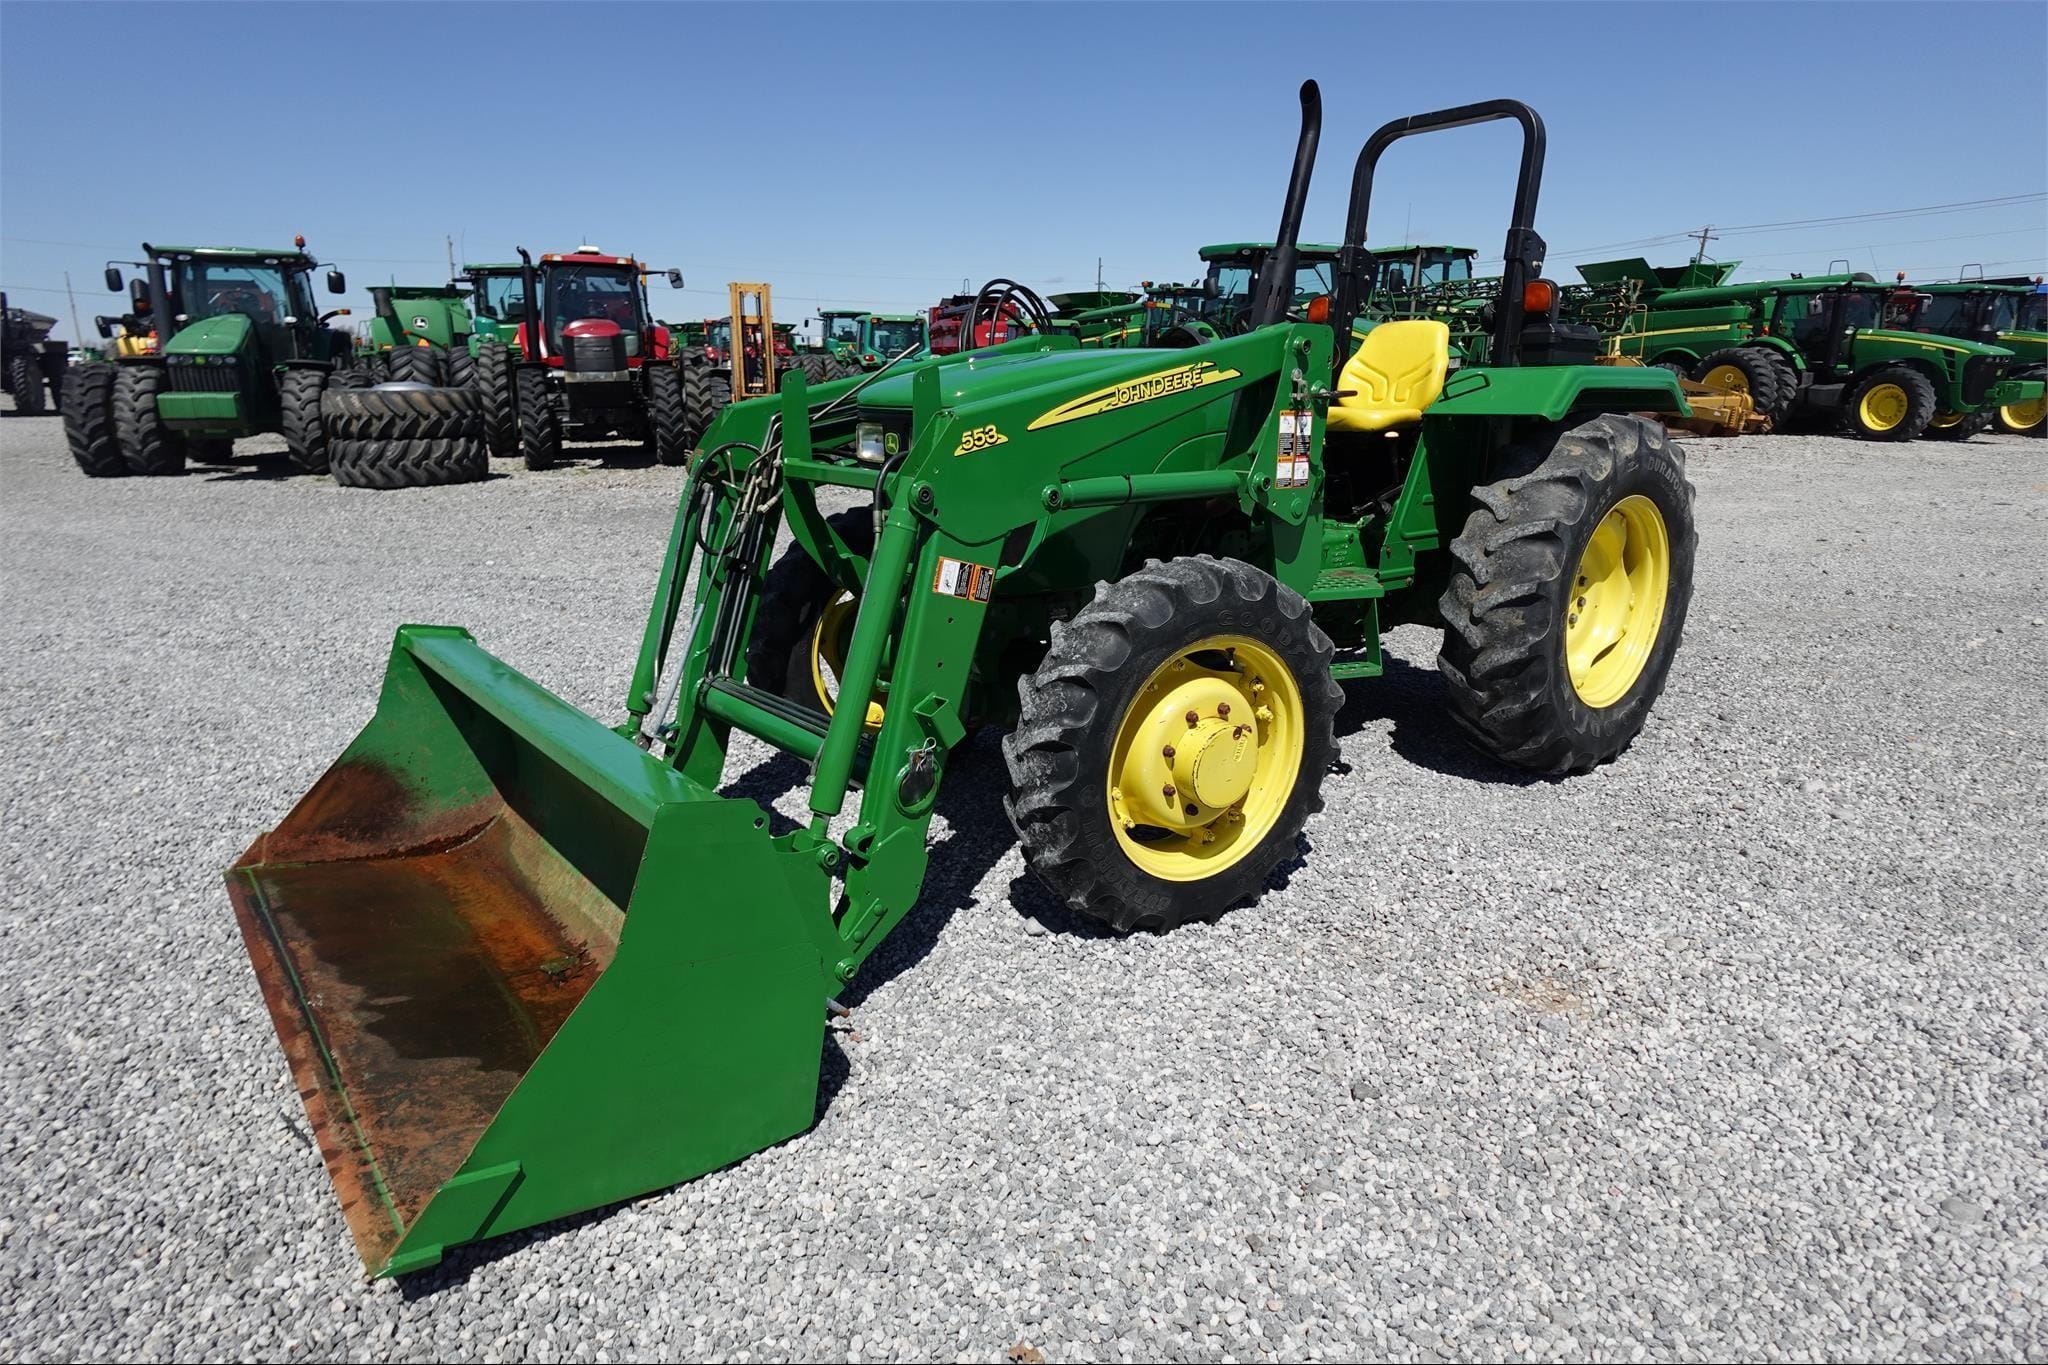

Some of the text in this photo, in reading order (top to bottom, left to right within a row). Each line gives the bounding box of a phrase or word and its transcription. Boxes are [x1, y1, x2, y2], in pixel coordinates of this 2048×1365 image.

[1110, 368, 1203, 406] JOHN DEERE
[961, 424, 998, 451] 553
